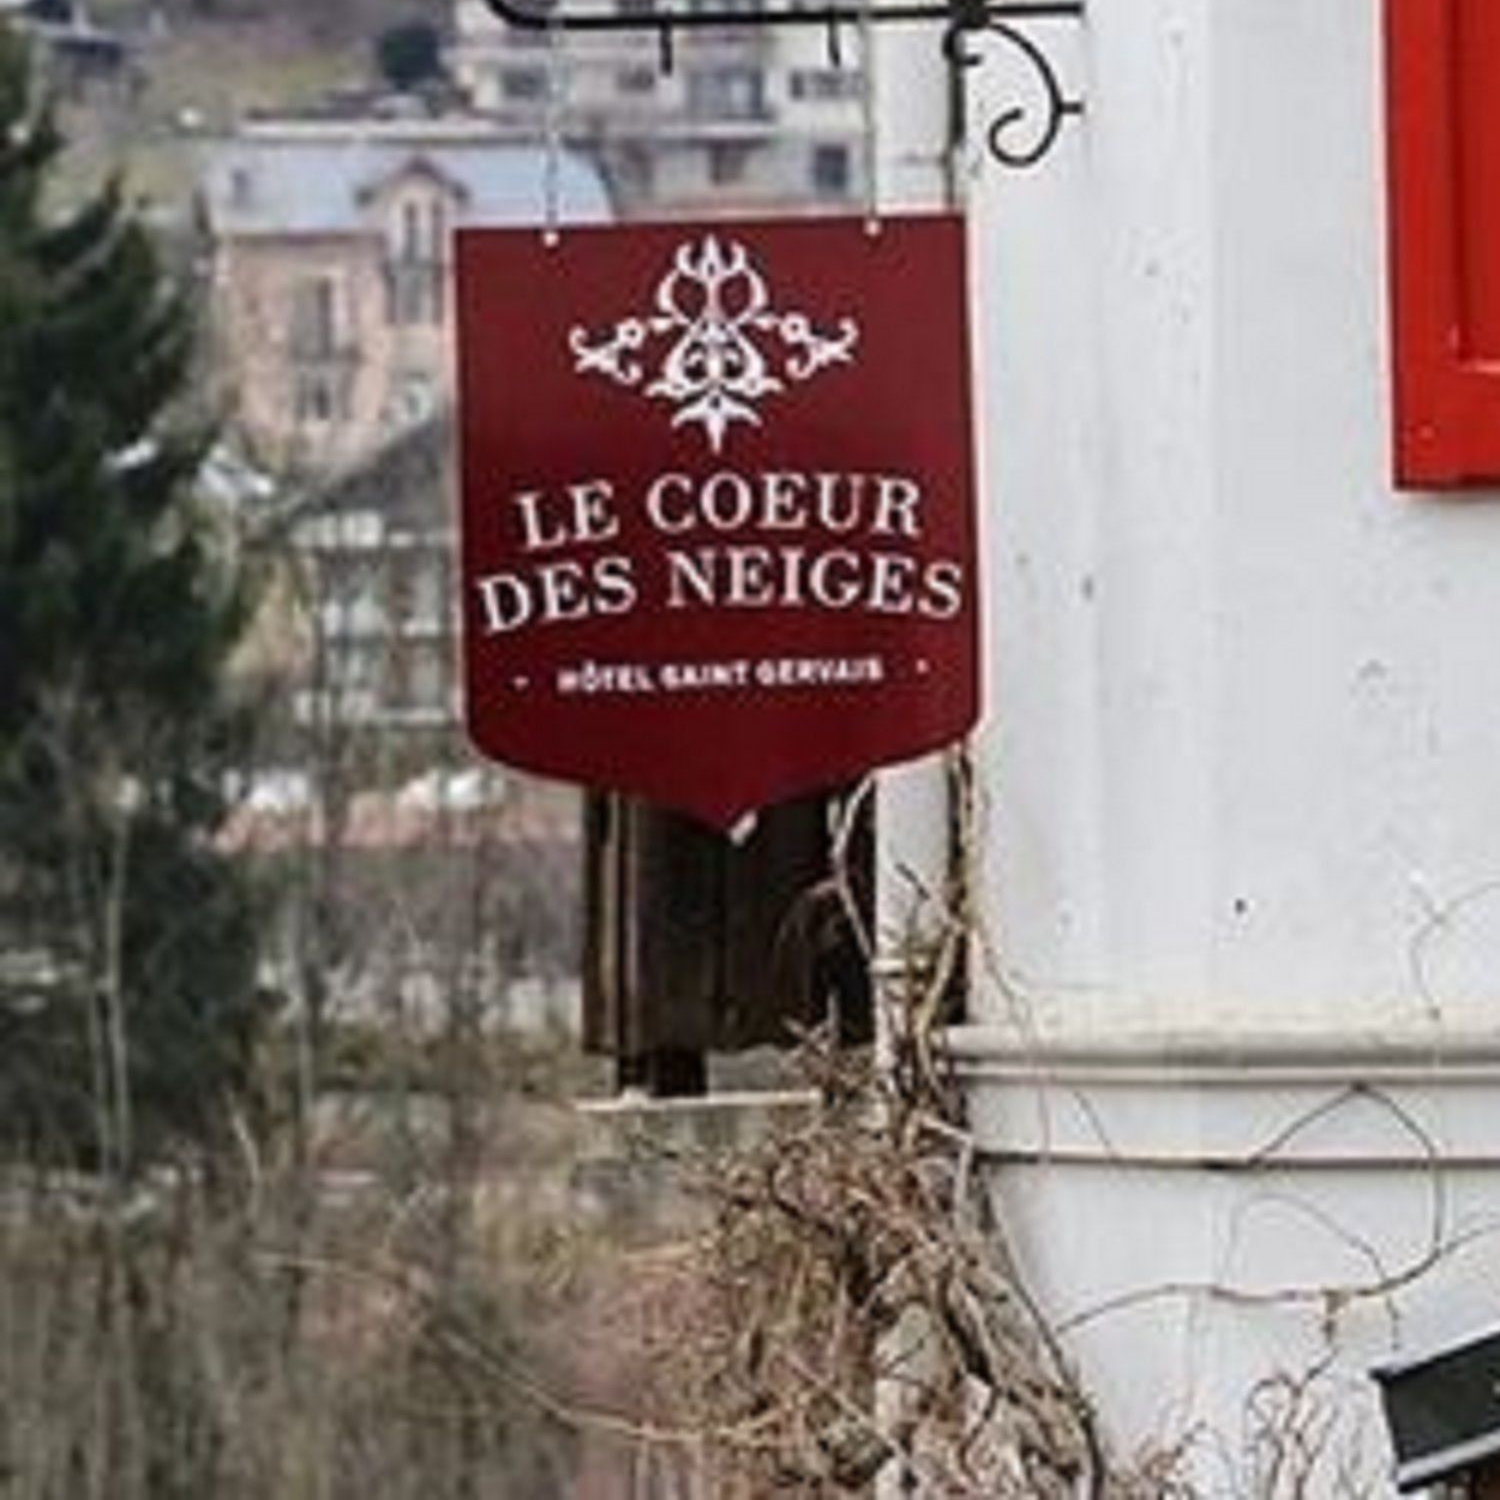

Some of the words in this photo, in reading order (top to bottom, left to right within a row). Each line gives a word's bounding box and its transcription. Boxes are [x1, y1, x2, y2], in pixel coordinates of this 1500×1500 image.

[516, 479, 620, 551] LE
[645, 471, 921, 538] COEUR
[477, 556, 638, 634] DES
[666, 545, 965, 621] NEIGES
[659, 659, 750, 690] SAINT
[754, 656, 884, 687] GERVAIS
